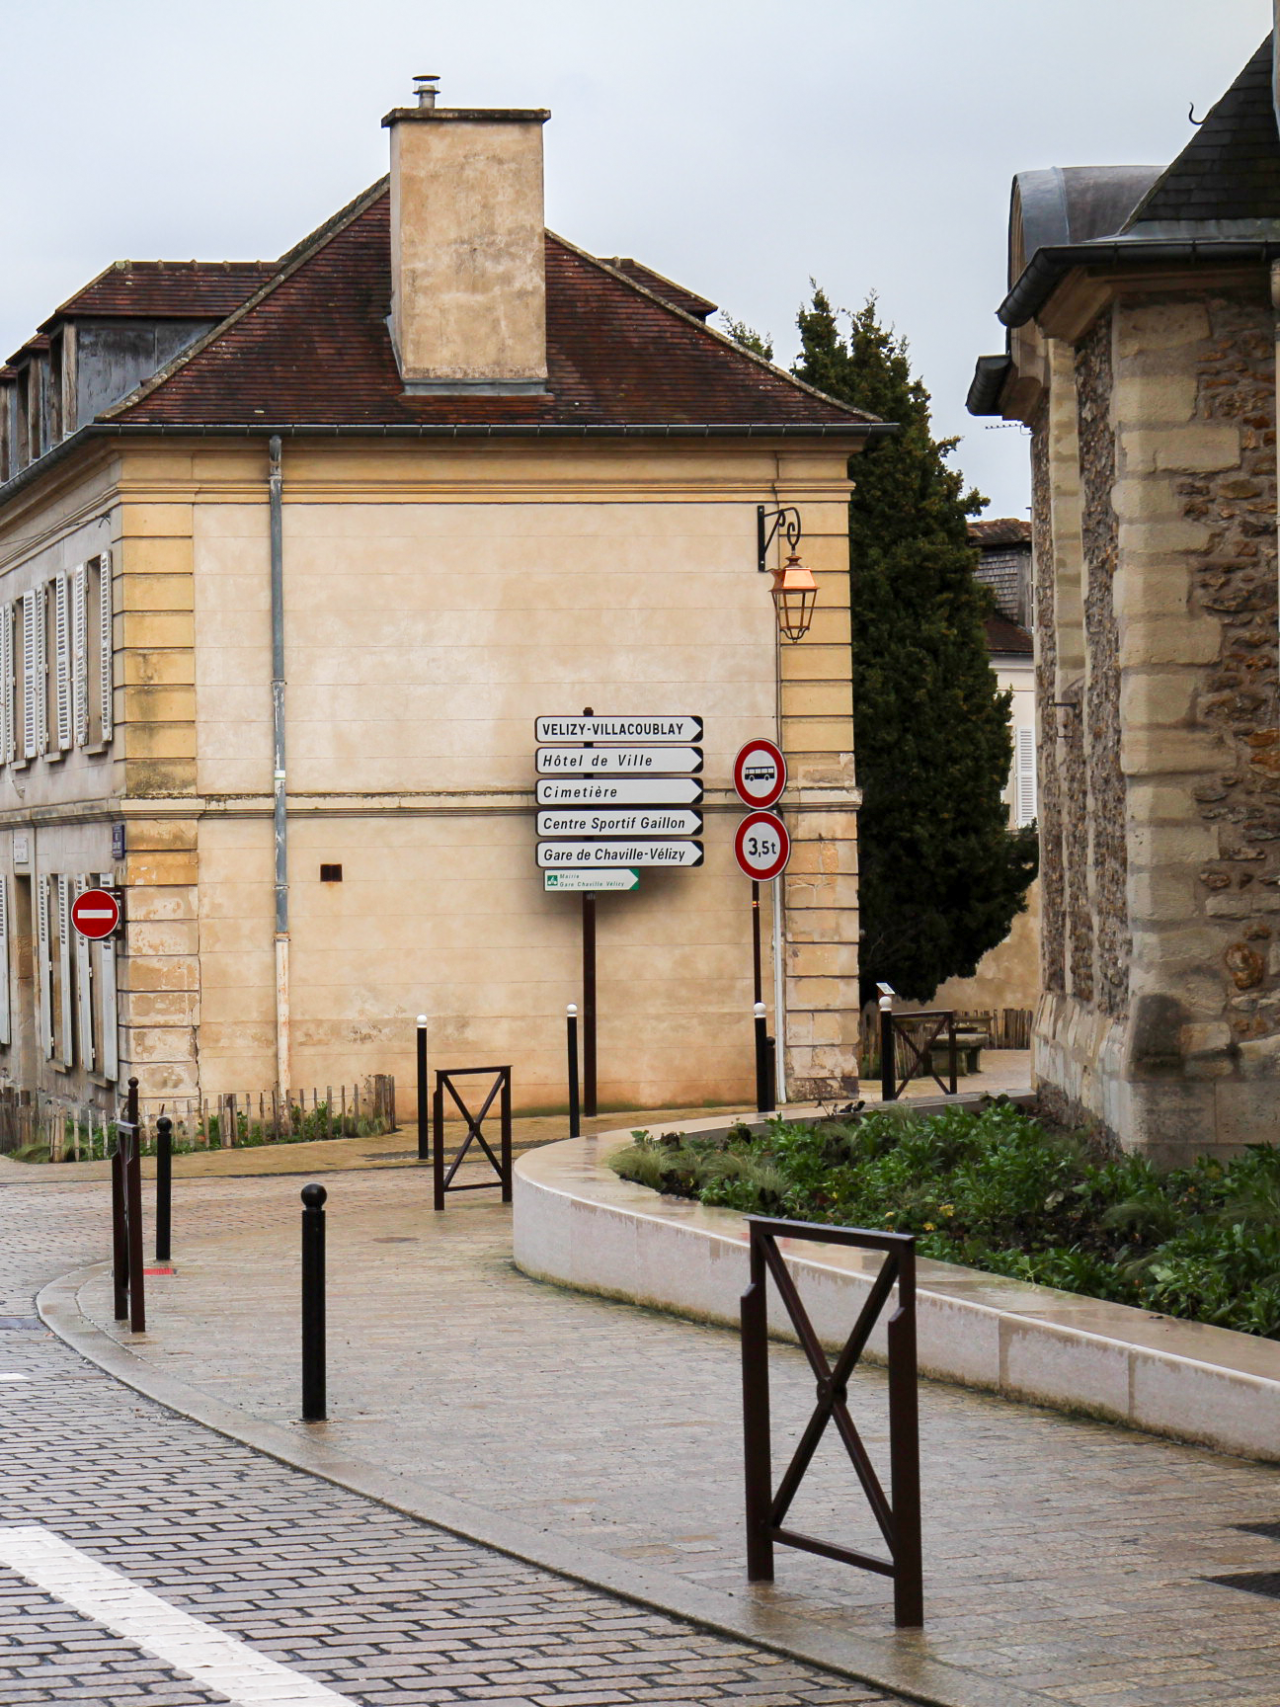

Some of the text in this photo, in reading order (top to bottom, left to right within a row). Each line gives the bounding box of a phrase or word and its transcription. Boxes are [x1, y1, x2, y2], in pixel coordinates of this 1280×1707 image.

[542, 723, 684, 735] VELIZY-VILLACOUBLAY
[543, 754, 652, 766] Hôtel de Ville
[543, 786, 617, 798] Cimetière
[543, 817, 685, 832] Centre Sportif Gaillon
[544, 848, 685, 862] Gare de Chaville-Vélizy
